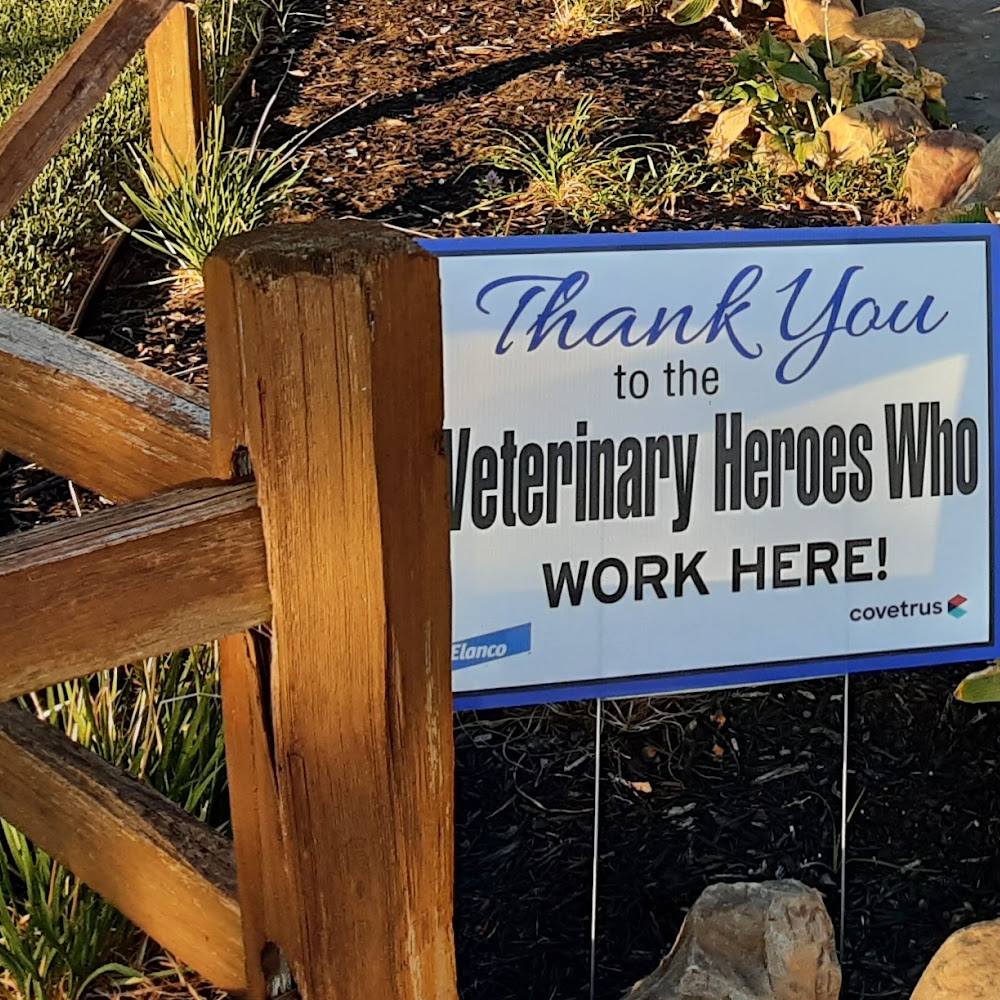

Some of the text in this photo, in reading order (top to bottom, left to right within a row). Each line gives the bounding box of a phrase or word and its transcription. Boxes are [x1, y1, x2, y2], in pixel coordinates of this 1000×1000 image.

[476, 265, 949, 385] Thank You
[614, 360, 719, 399] to the
[443, 401, 978, 533] Veterinary Heroes Who
[542, 536, 887, 608] WORK HERE!
[849, 599, 943, 623] covetrus
[452, 642, 508, 661] Elanco
